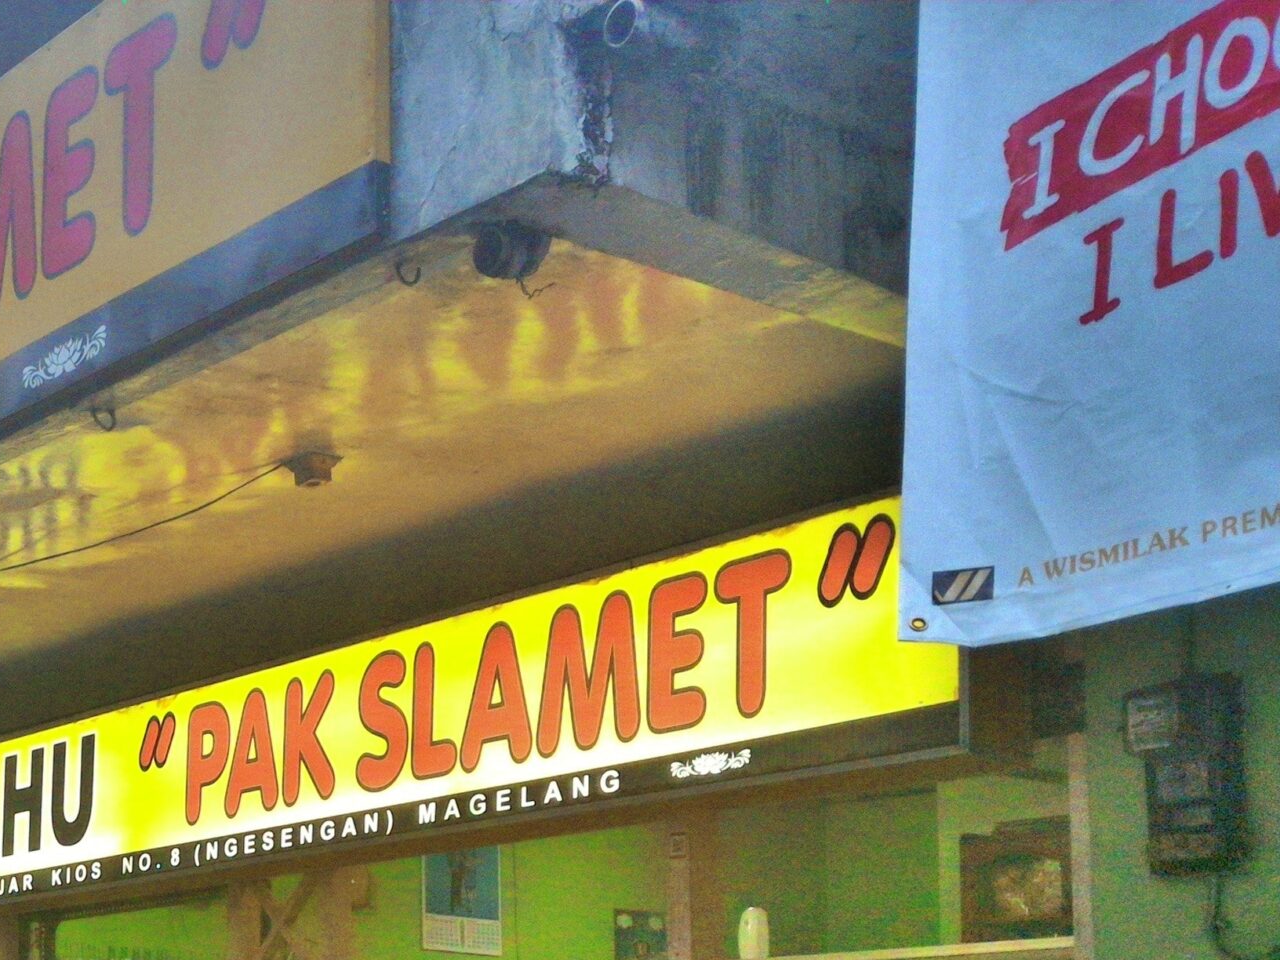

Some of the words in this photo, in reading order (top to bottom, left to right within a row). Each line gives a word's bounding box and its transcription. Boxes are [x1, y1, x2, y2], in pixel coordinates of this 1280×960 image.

[1023, 119, 1065, 219] I
[1078, 16, 1280, 176] CHO
[1079, 217, 1125, 325] I
[1018, 566, 1034, 587] A
[1043, 526, 1190, 580] WISMILAK
[51, 862, 102, 888] KIOS
[122, 852, 163, 874] NO.
[170, 848, 180, 867] 8
[194, 812, 393, 868] (NGESENGAN)
[418, 770, 621, 825] MAGELANG
